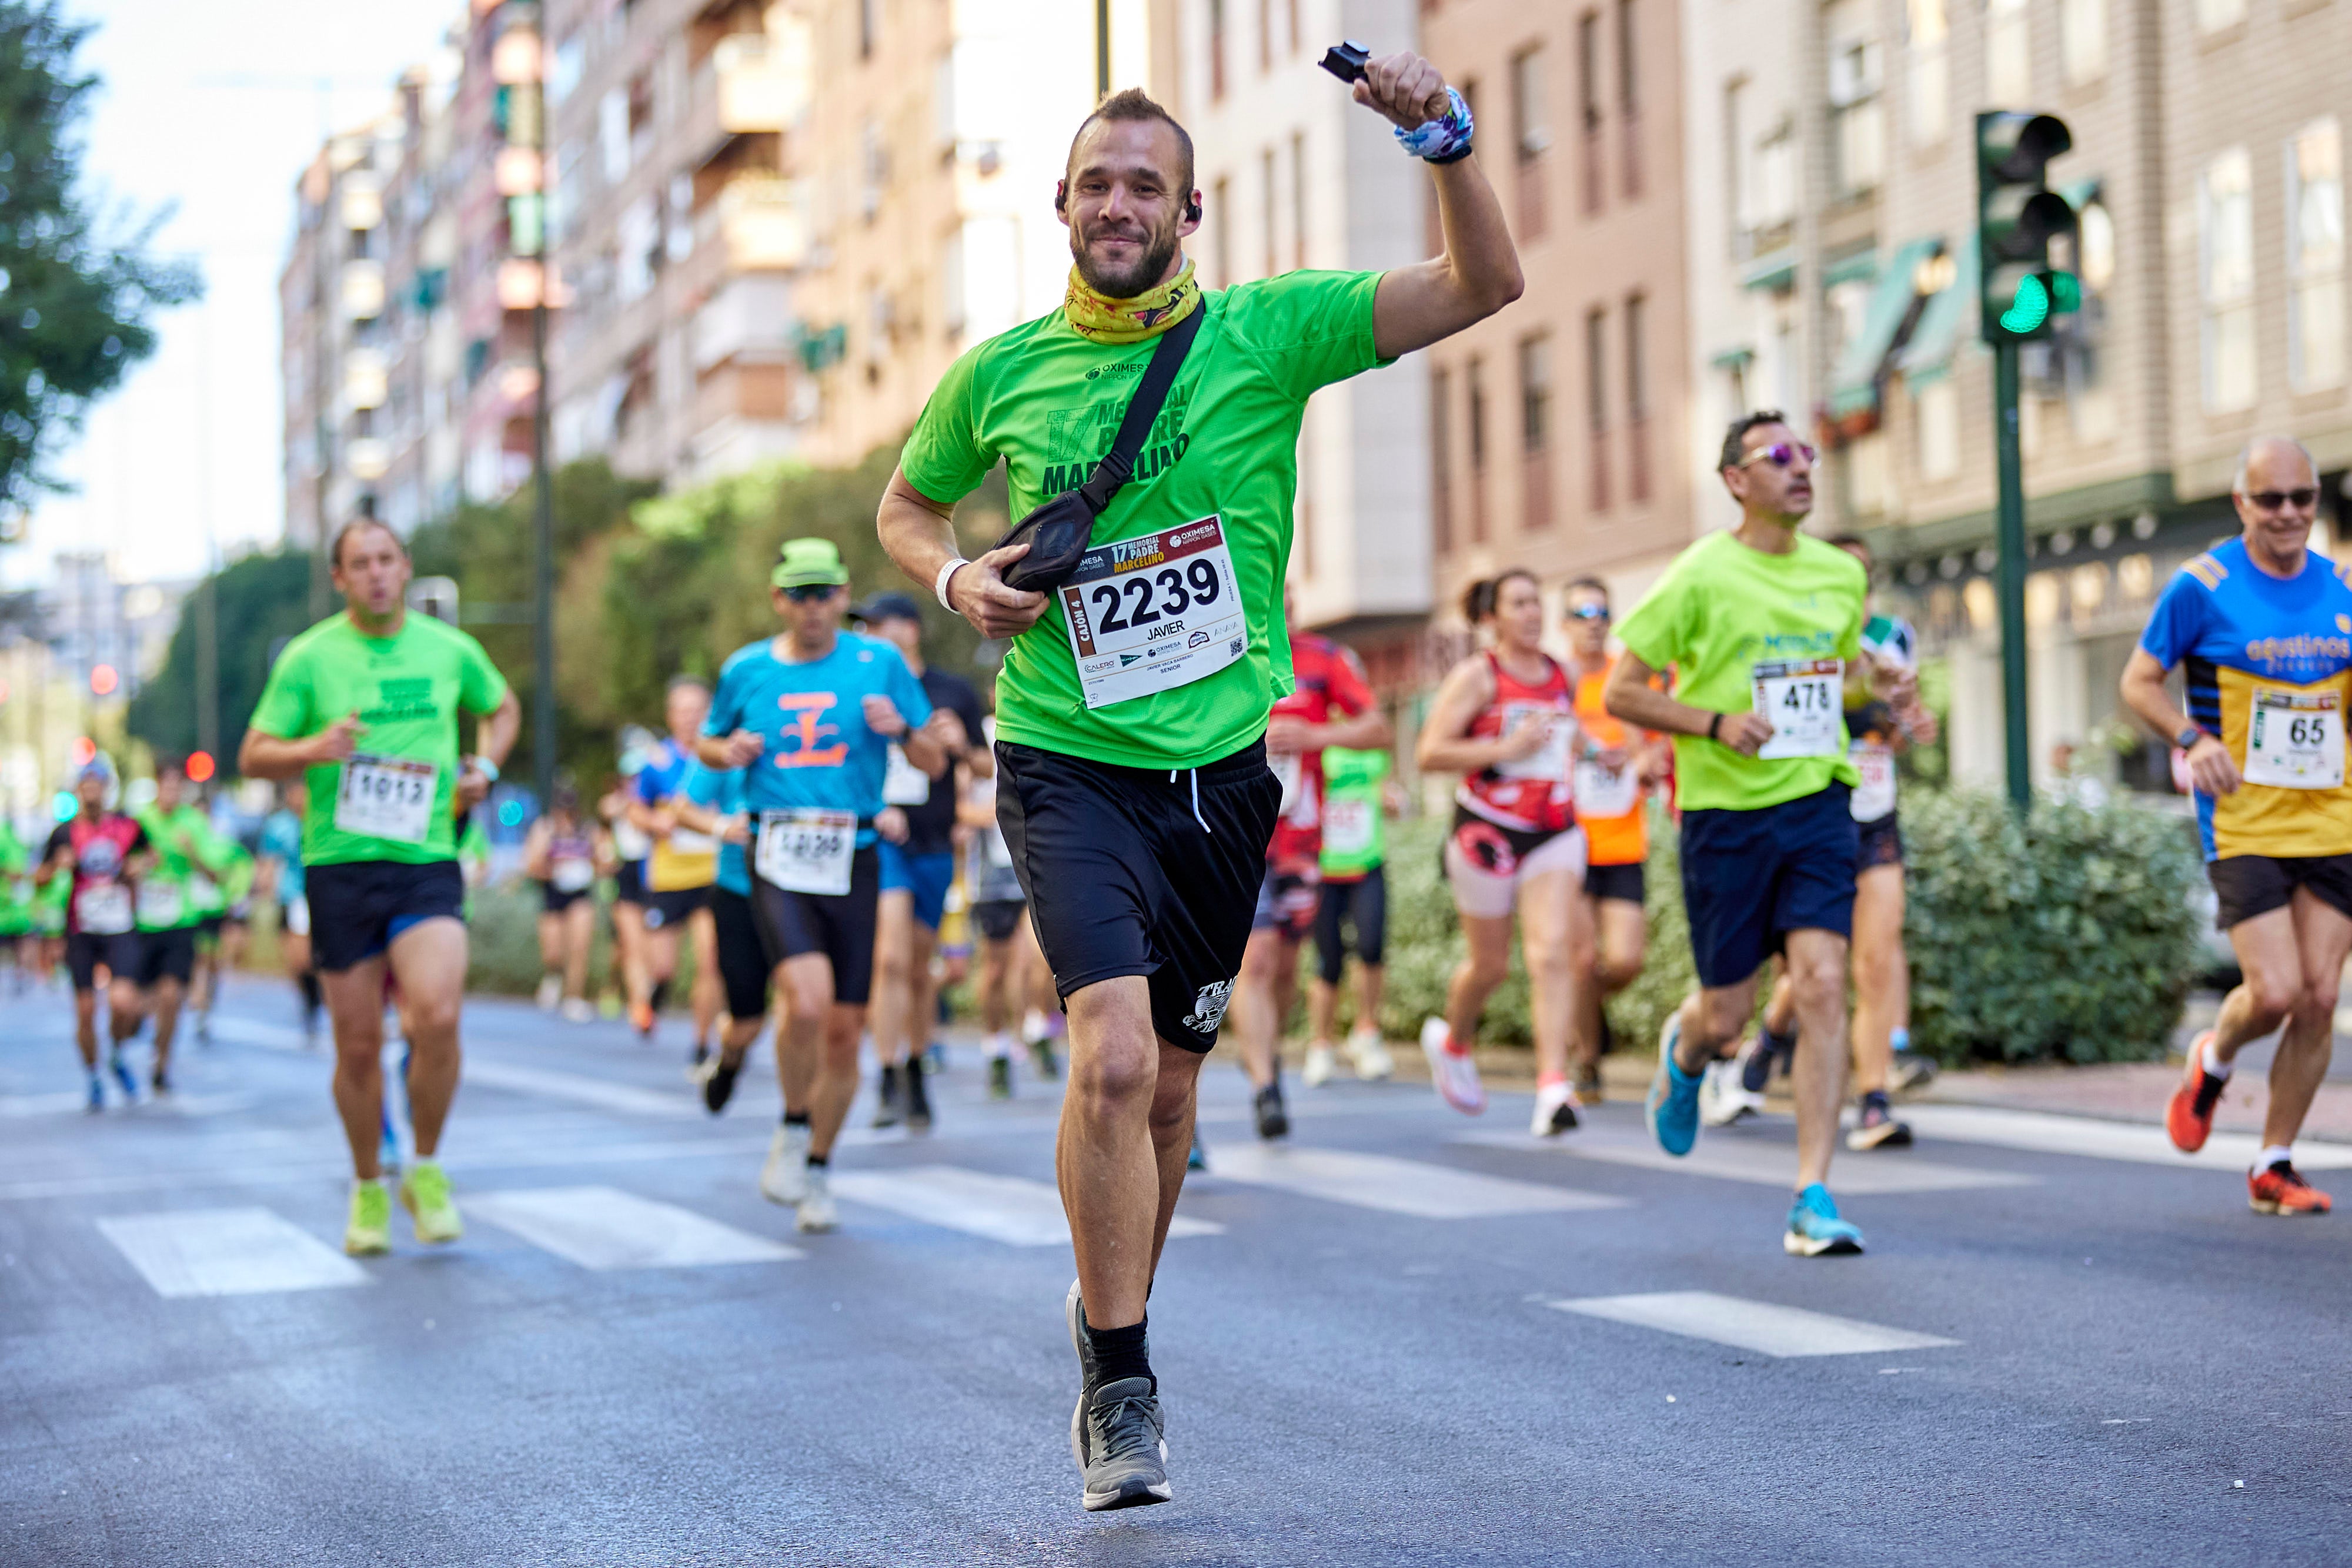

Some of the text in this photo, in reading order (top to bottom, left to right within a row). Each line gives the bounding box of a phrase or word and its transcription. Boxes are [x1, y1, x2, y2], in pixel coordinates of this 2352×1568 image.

[1102, 363, 1149, 373] OXIMES
[1098, 409, 1183, 456] PRE
[1181, 524, 1215, 540] OXIMESA
[1128, 536, 1160, 550] MEMORIAL
[1130, 543, 1159, 559] PADRE
[1080, 556, 1103, 566] IMESA
[1111, 543, 1128, 563] 17
[1114, 551, 1164, 573] MARCELINO
[1092, 559, 1220, 635] 2239
[1074, 610, 1090, 641] CAJÓN
[1148, 620, 1185, 640] JAVIER
[1156, 641, 1181, 653] OXIMESA
[1086, 661, 1114, 671] CALERO
[1174, 654, 1194, 663] BARBERO
[1160, 664, 1181, 674] SENIOR
[1784, 682, 1829, 712] 478
[2290, 718, 2324, 745] 65
